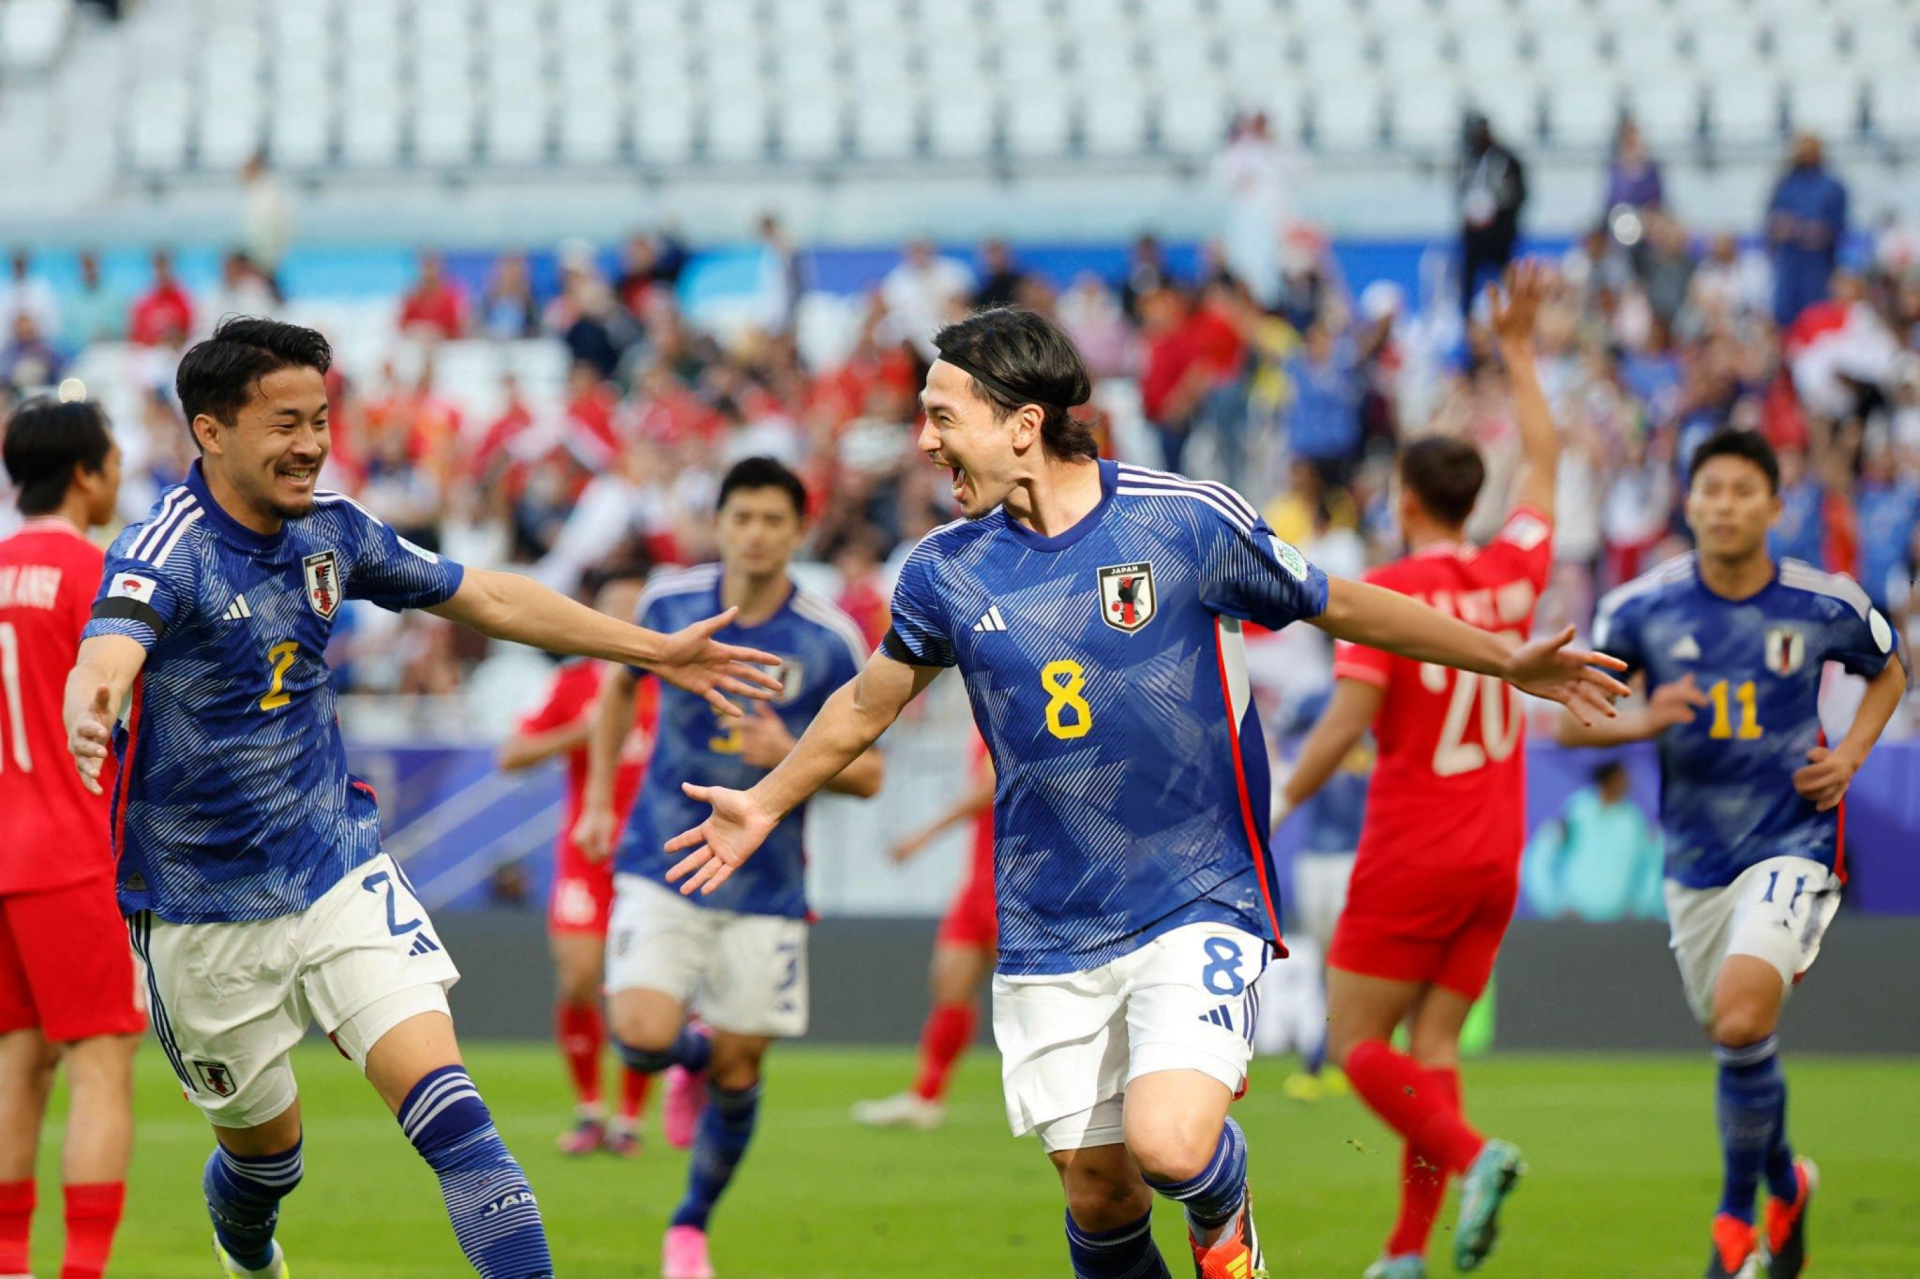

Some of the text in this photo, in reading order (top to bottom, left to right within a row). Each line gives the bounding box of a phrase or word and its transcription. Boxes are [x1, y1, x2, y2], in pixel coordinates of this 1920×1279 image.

[1111, 565, 1138, 575] JAPAN
[260, 641, 299, 711] 2
[1041, 659, 1092, 740] 8
[1709, 680, 1763, 739] 11
[361, 870, 423, 937] 2
[1203, 937, 1245, 997] 8
